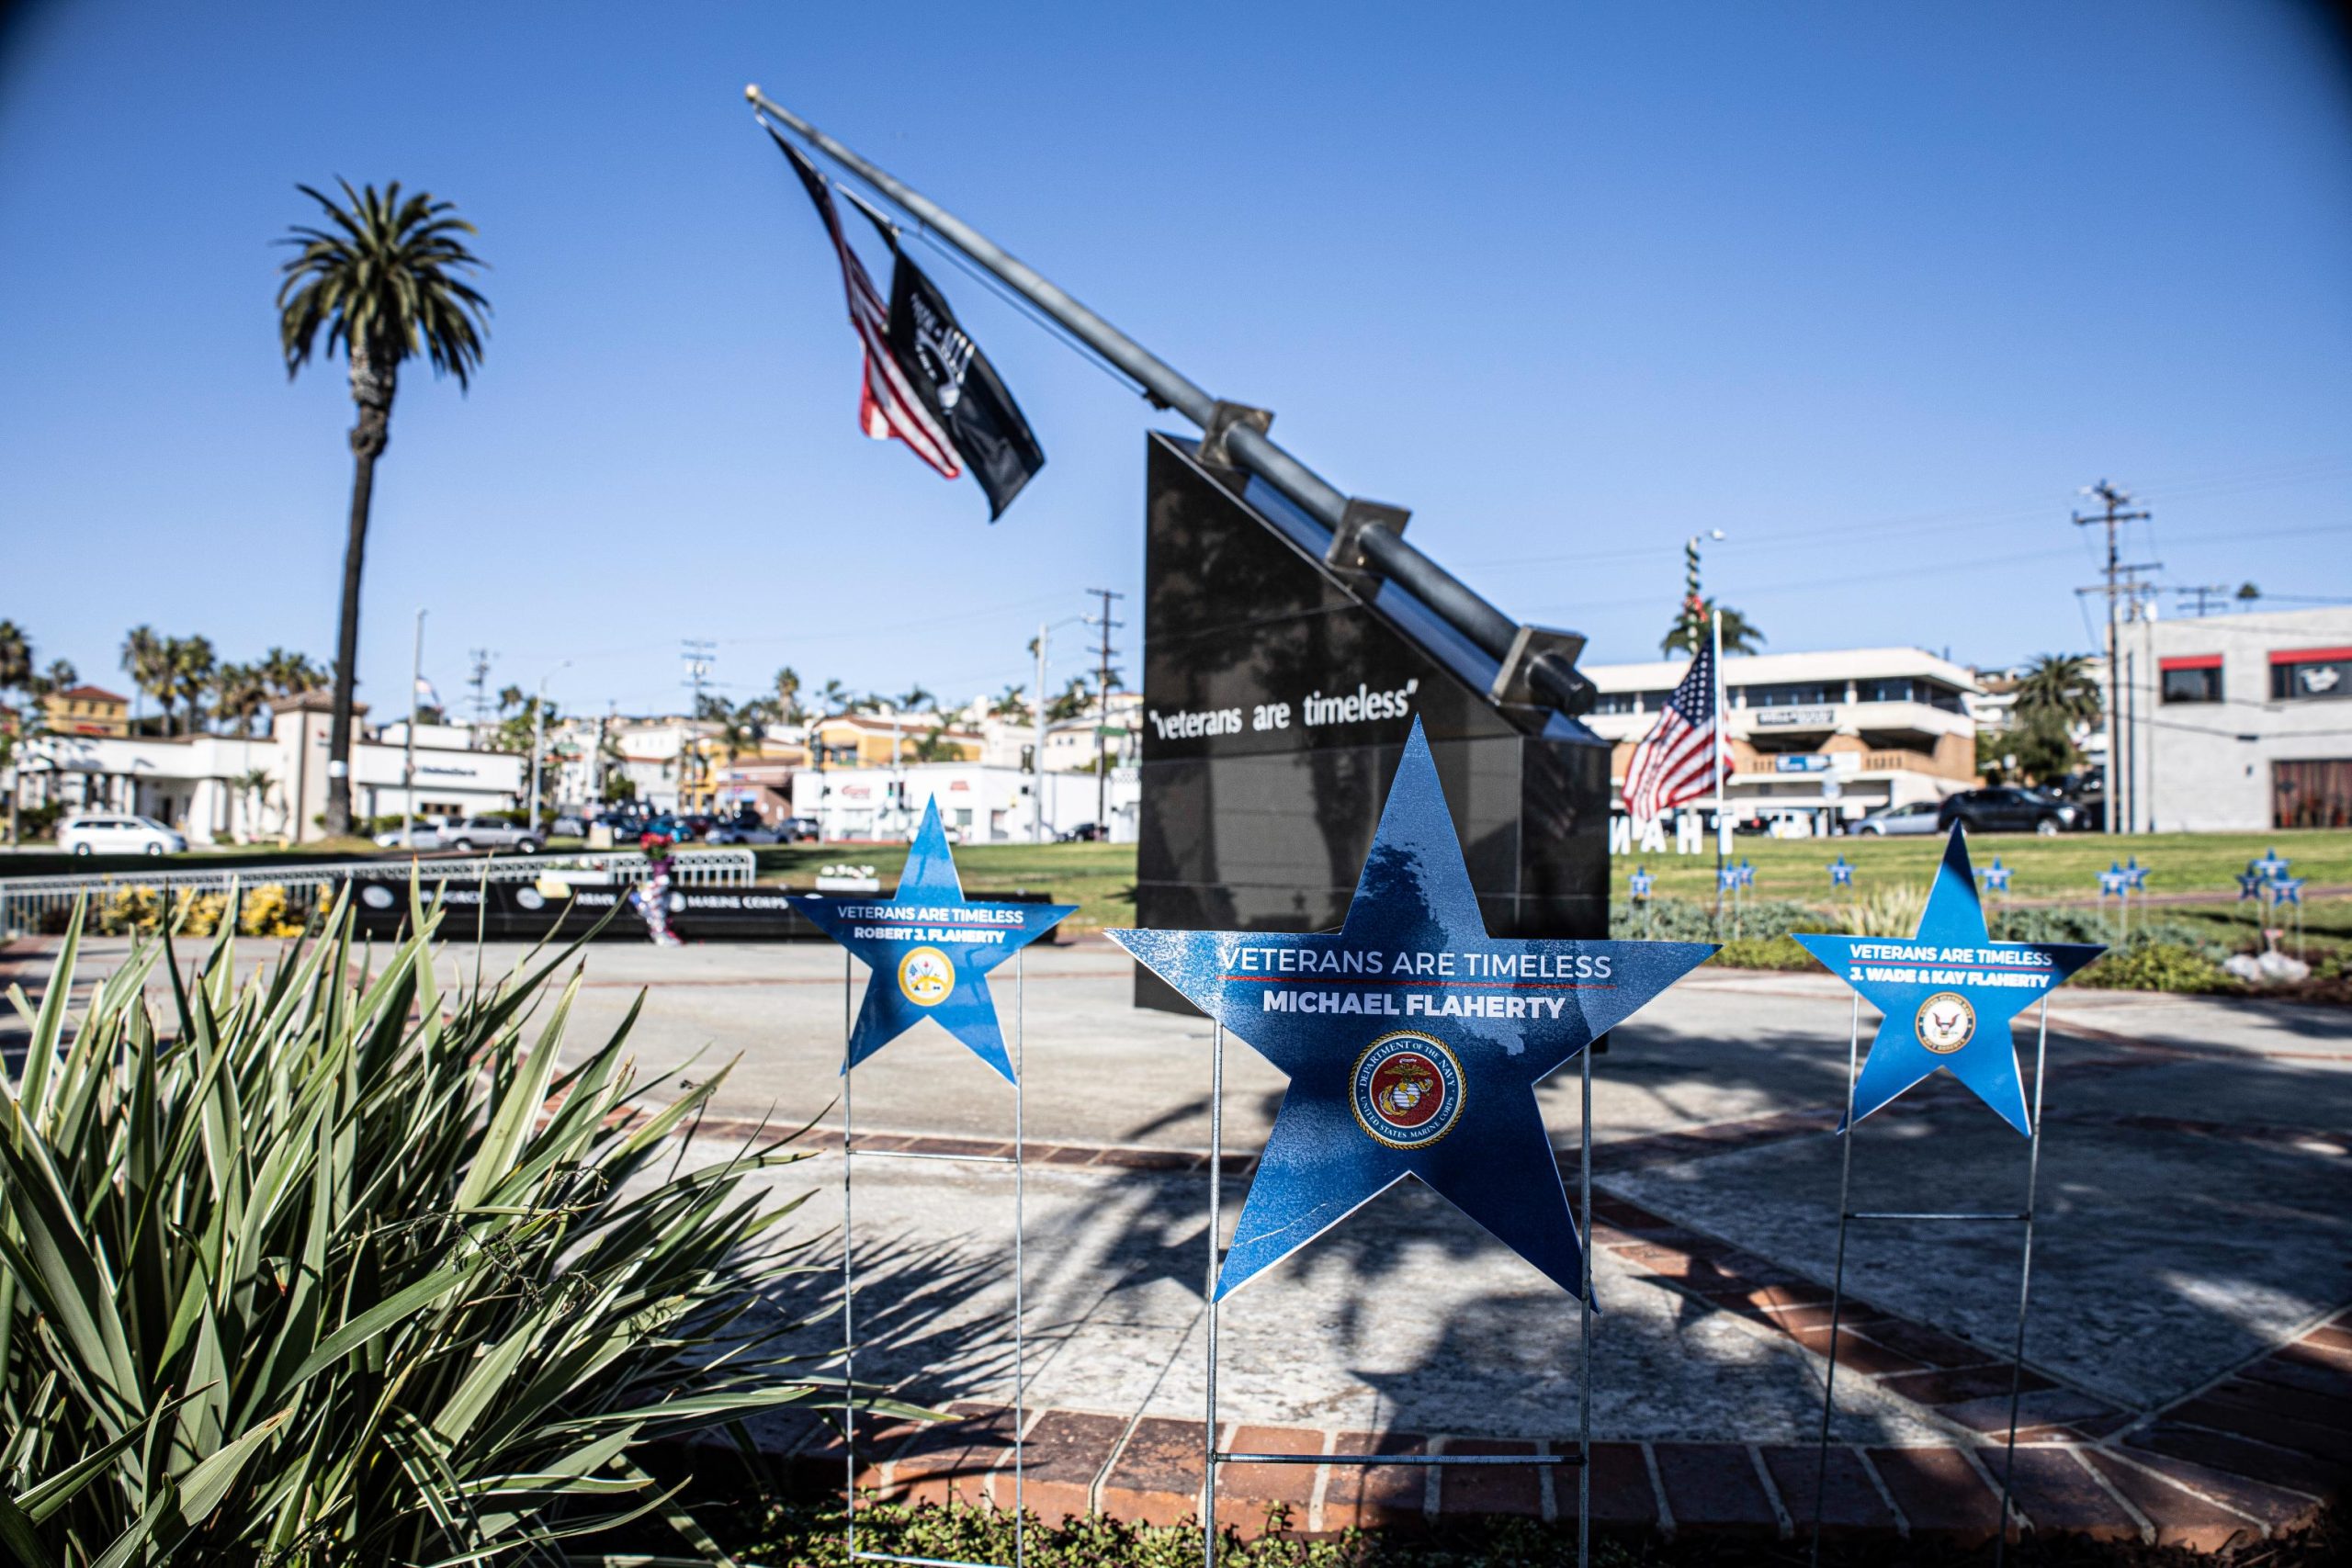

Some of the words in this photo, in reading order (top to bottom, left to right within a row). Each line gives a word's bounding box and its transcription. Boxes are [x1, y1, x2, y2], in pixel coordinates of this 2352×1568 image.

[1252, 702, 1291, 732] are
[1303, 678, 1419, 727] timeless"
[686, 895, 741, 908] MARINE
[741, 895, 789, 909] CORPS
[837, 906, 917, 921] VETERANS
[917, 908, 949, 921] ARE
[951, 908, 1024, 924] TIMELESS
[854, 927, 913, 942] ROBERT
[913, 929, 927, 942] J.
[927, 929, 1007, 944] FLAHERTY
[1220, 947, 1383, 975] VETERANS
[1391, 952, 1455, 977] ARE
[1464, 953, 1612, 979] TIMELESS
[1849, 943, 1938, 962] VETERANS
[1939, 947, 1974, 964] ARE
[1975, 949, 2053, 966] TIMELESS
[1849, 966, 1864, 981] J.
[1866, 967, 1917, 984] WADE
[1917, 969, 1930, 984] &
[1931, 969, 1968, 986] KAY
[1966, 972, 2051, 989] FLAHERTY
[1263, 989, 1400, 1017] MICHAEL
[1406, 993, 1567, 1019] FLAHERTY
[1359, 1040, 1411, 1088] DEPARTMENT
[1412, 1042, 1423, 1050] OF
[1424, 1045, 1440, 1060] THE
[1438, 1059, 1456, 1087] NAVY
[1360, 1096, 1379, 1125] UNITED
[1379, 1123, 1408, 1138] STATES
[1410, 1122, 1441, 1138] MARINE
[1439, 1096, 1454, 1122] CORPS
